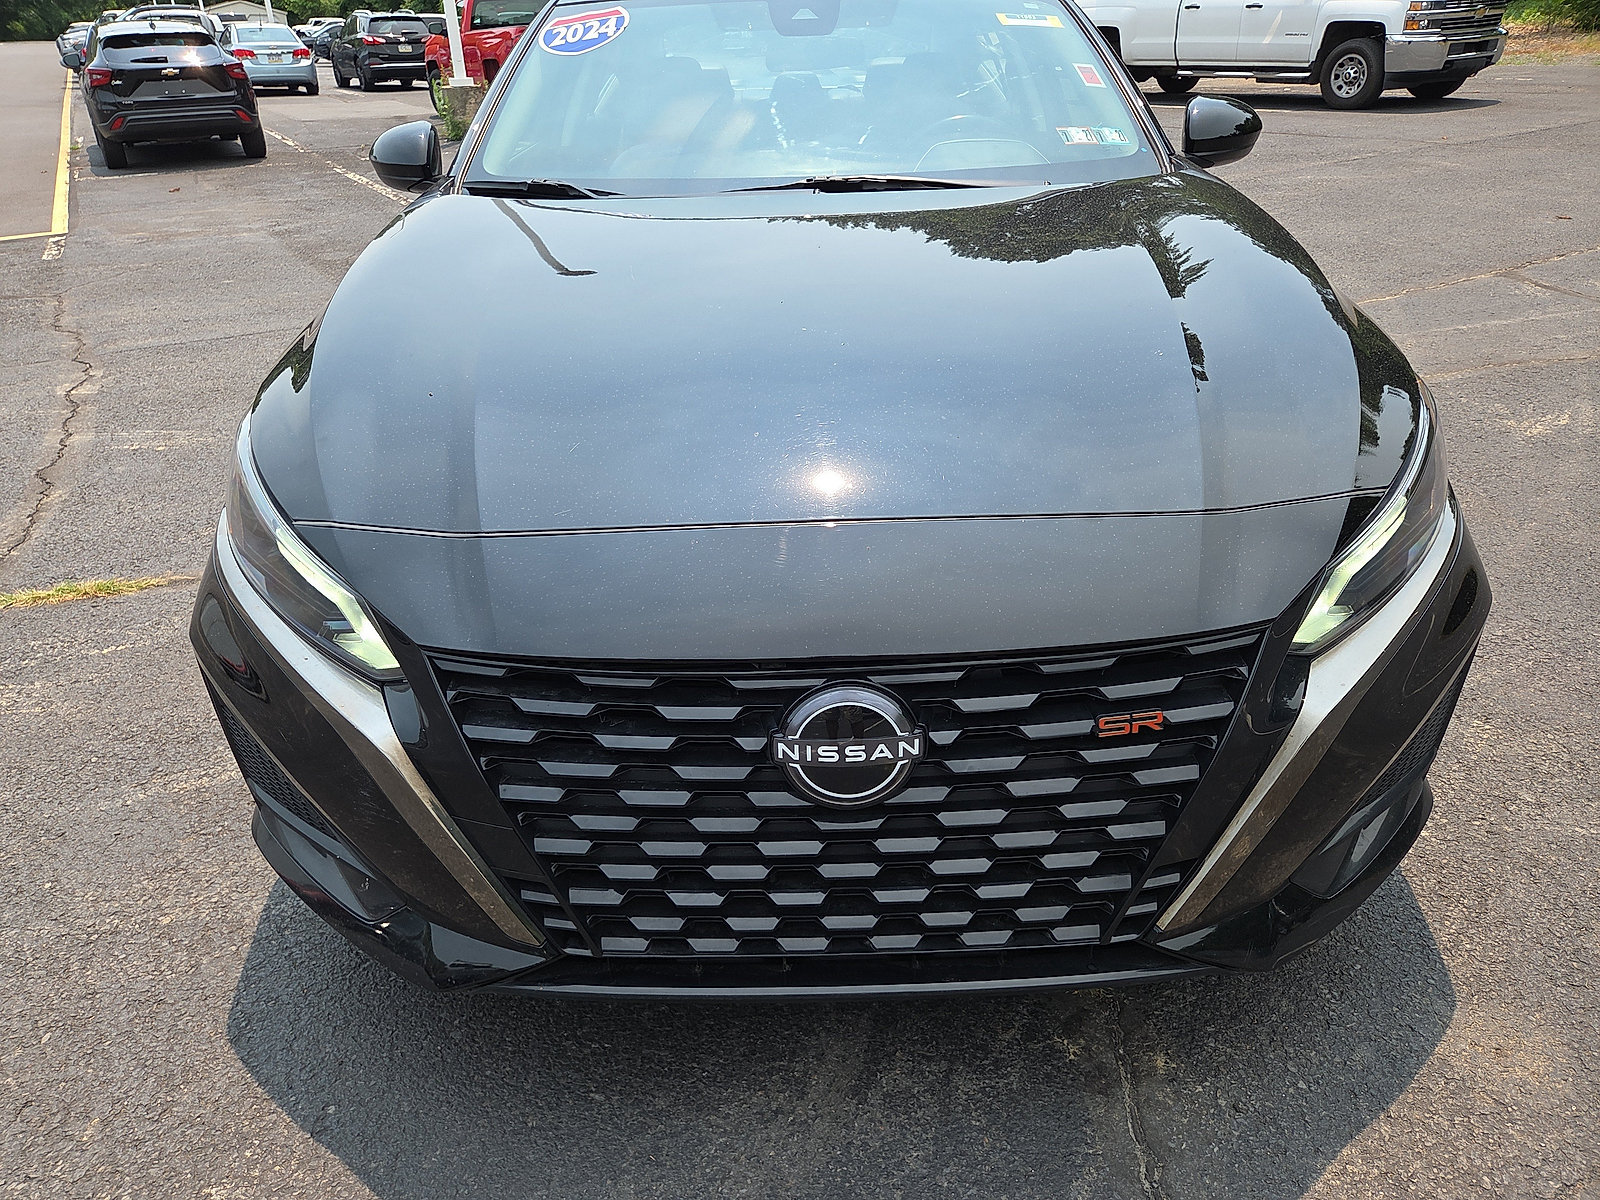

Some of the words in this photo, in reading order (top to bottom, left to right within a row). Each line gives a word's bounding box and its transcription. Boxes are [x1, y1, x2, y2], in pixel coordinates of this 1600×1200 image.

[549, 17, 617, 48] 2024
[1096, 709, 1164, 737] SR
[776, 738, 920, 764] NISSAN
